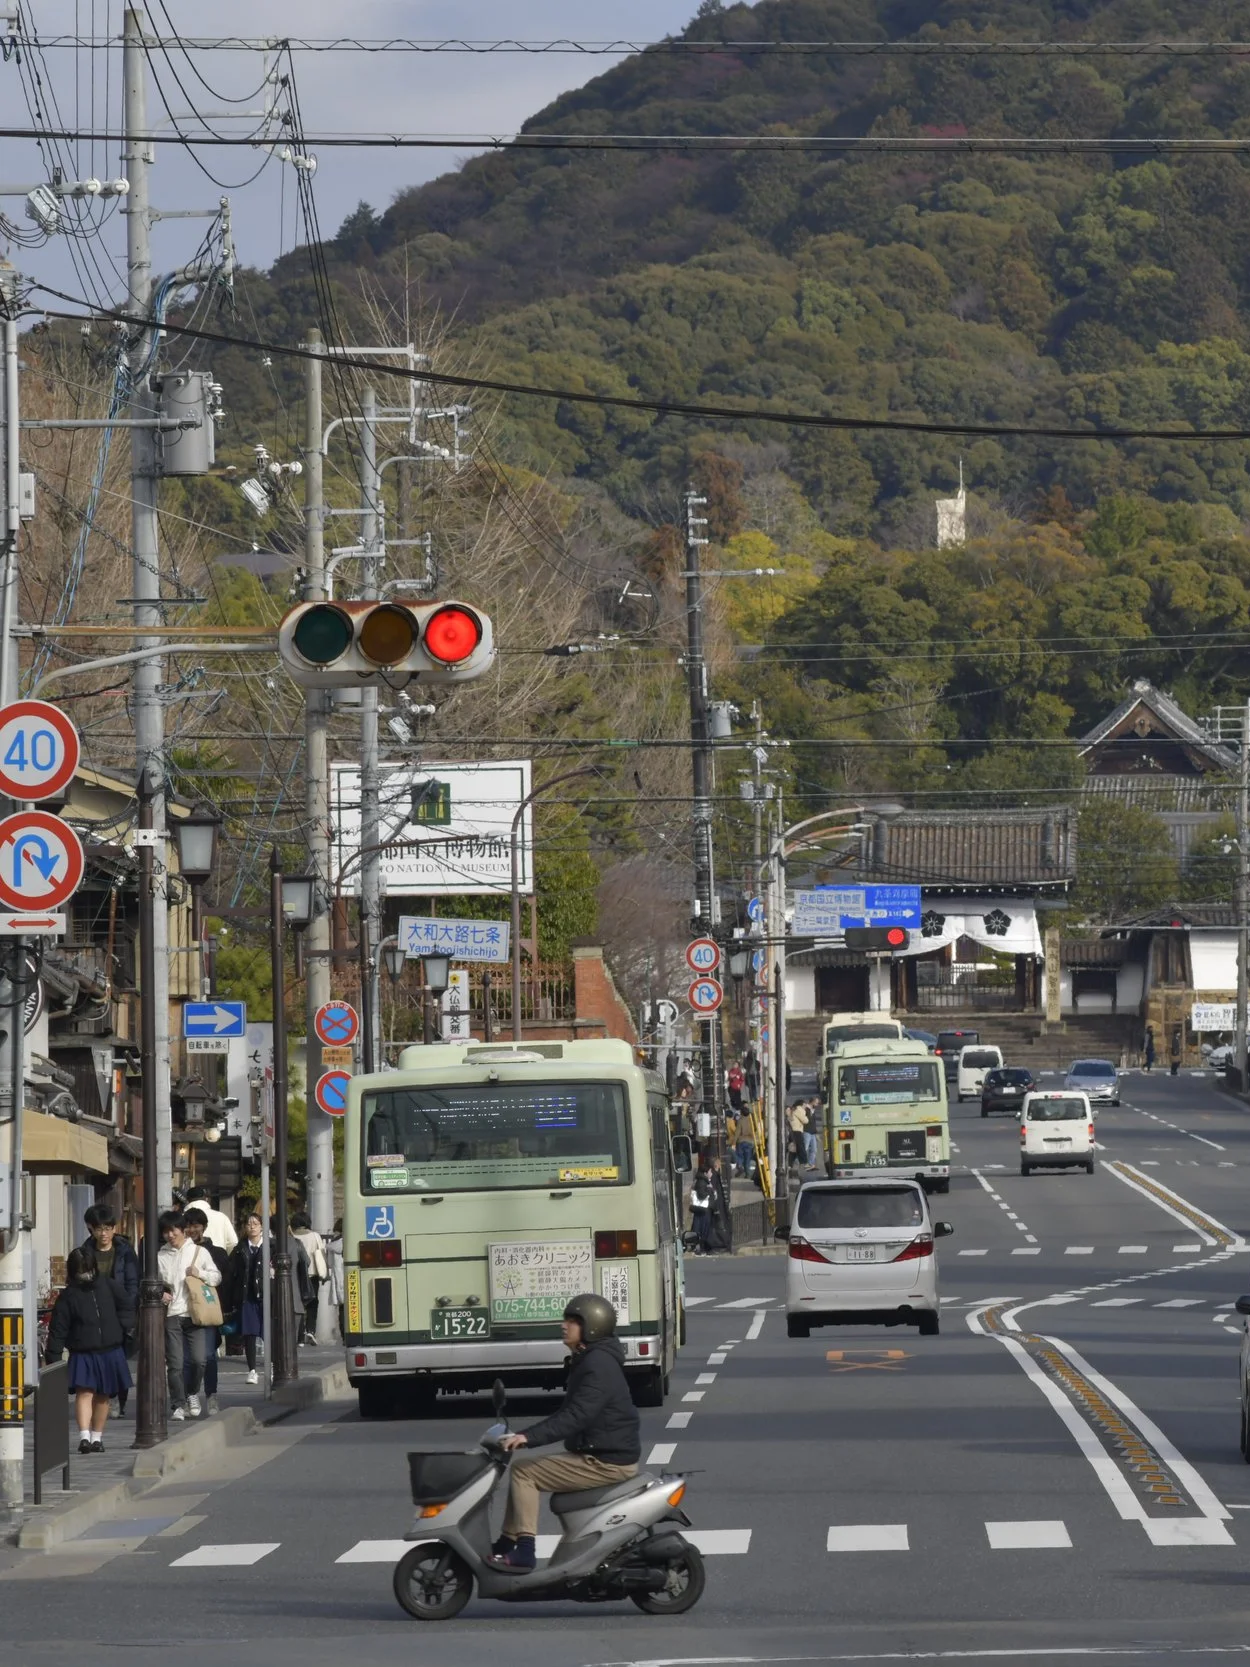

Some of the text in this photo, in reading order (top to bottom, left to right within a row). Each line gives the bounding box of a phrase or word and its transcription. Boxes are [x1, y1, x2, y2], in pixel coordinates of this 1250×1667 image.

[4, 730, 55, 771] 40
[398, 863, 457, 873] NATIONAL
[461, 863, 510, 873] MUSEUM
[407, 923, 501, 944] 大和大路七条
[408, 942, 498, 958] Yamatoojishichijo
[694, 948, 713, 964] 40
[448, 984, 460, 1034] 大仏前交番
[188, 1041, 228, 1050] 自転車を除く
[494, 1251, 591, 1267] あおきクリニック
[619, 1266, 629, 1310] バスの発進に
[444, 1318, 486, 1336] 15-22
